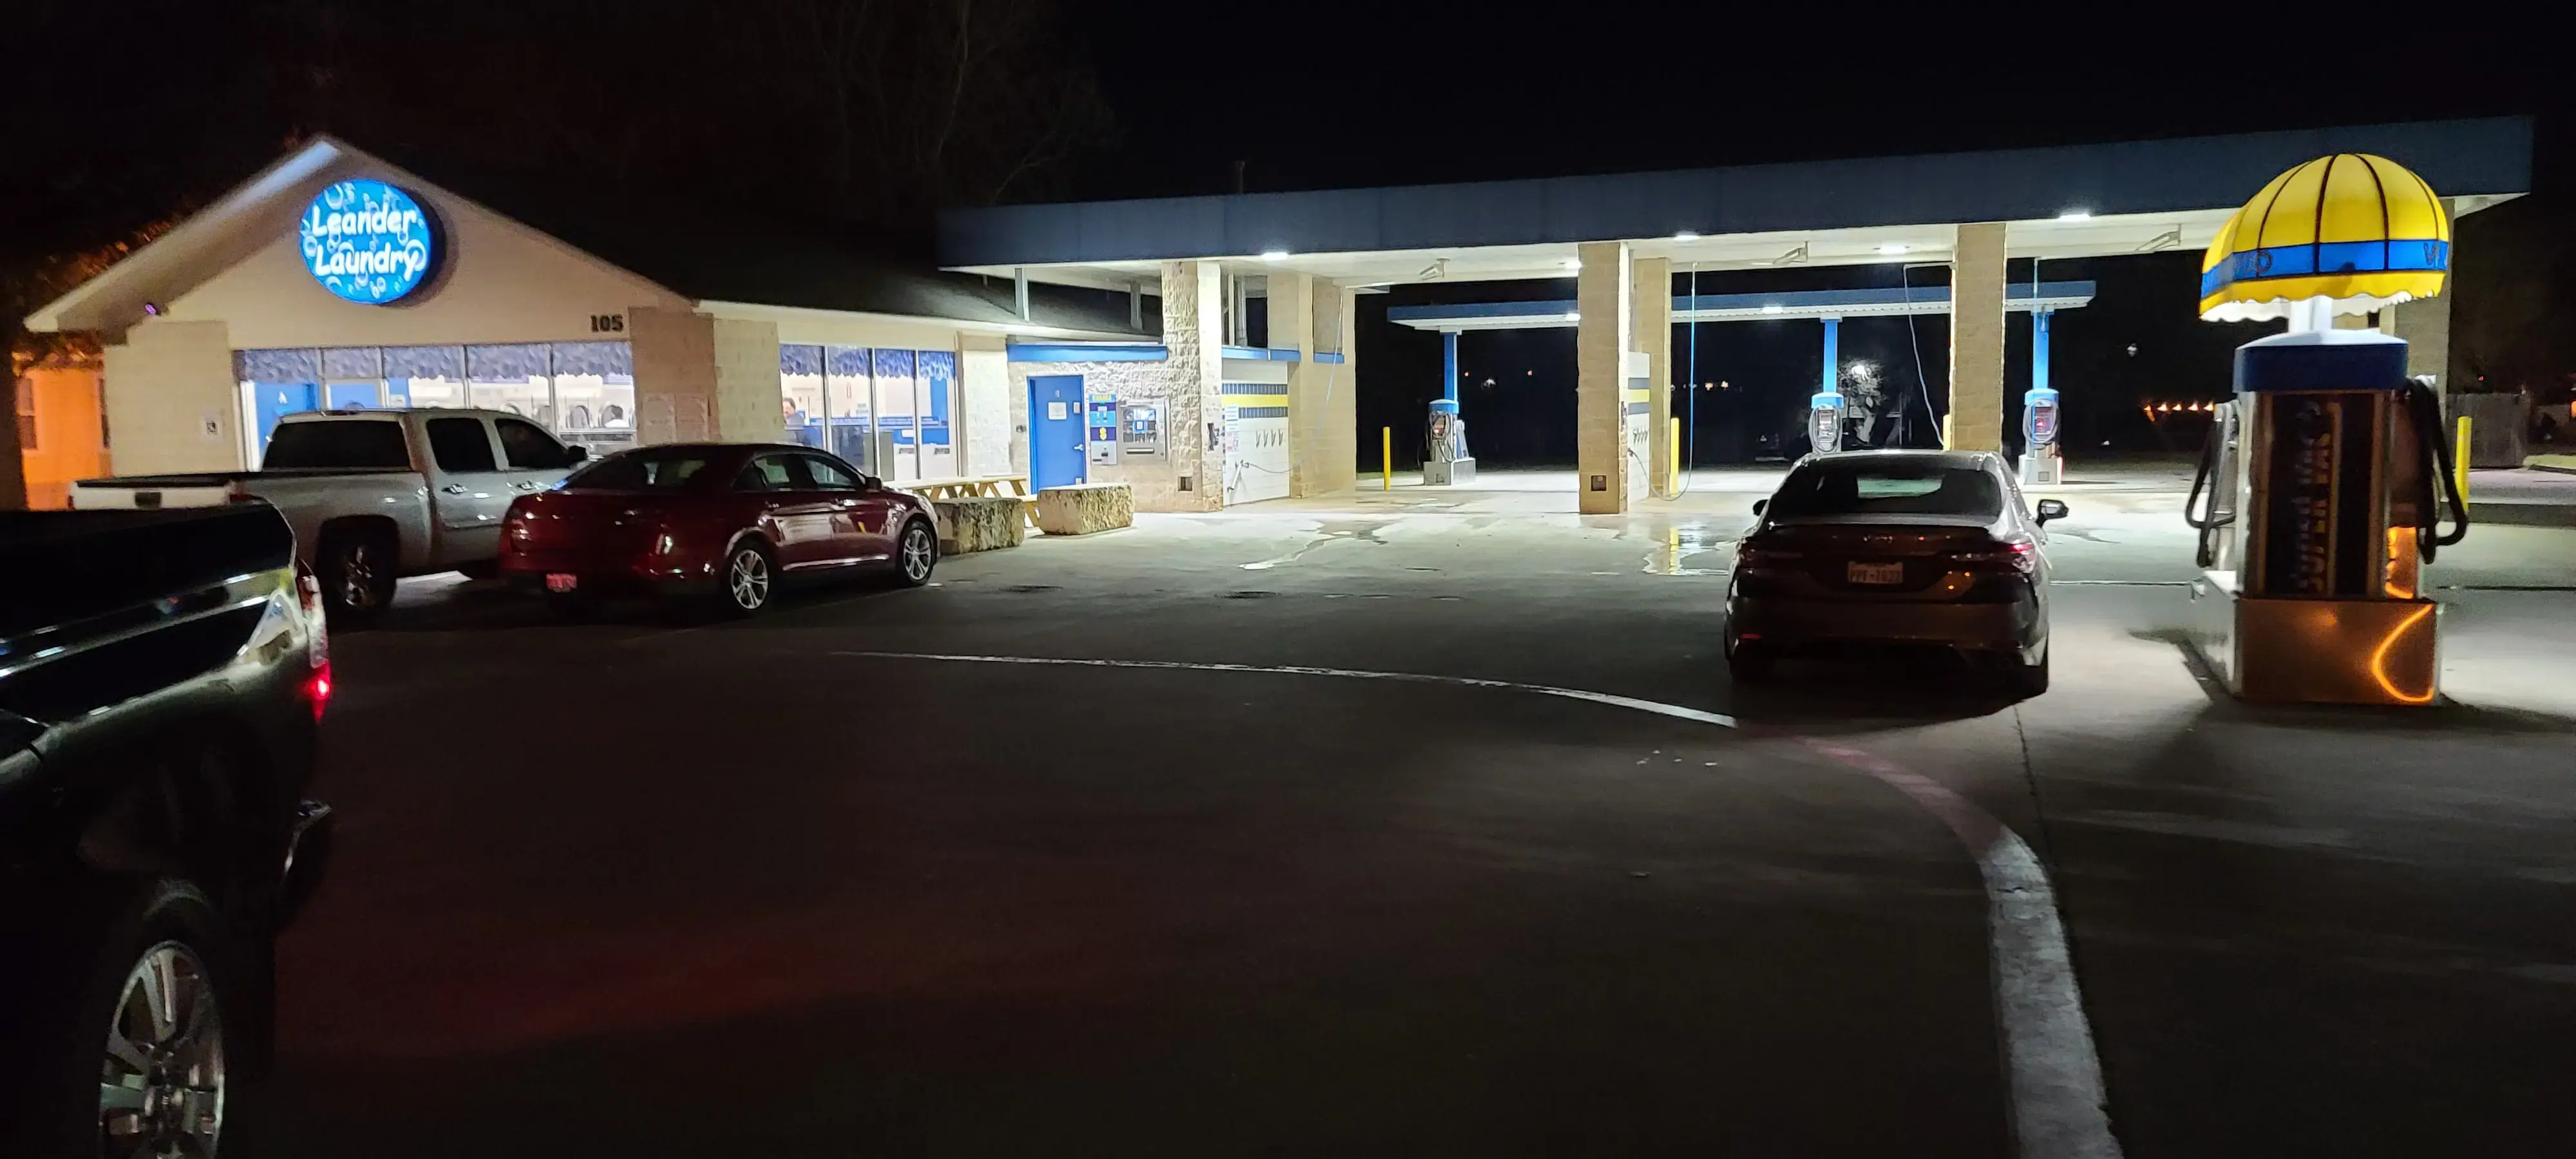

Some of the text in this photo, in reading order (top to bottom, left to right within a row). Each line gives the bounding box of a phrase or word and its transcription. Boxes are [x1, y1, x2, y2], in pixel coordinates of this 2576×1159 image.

[311, 202, 417, 237] Leander
[314, 241, 420, 282] Laundry
[591, 314, 624, 333] 105
